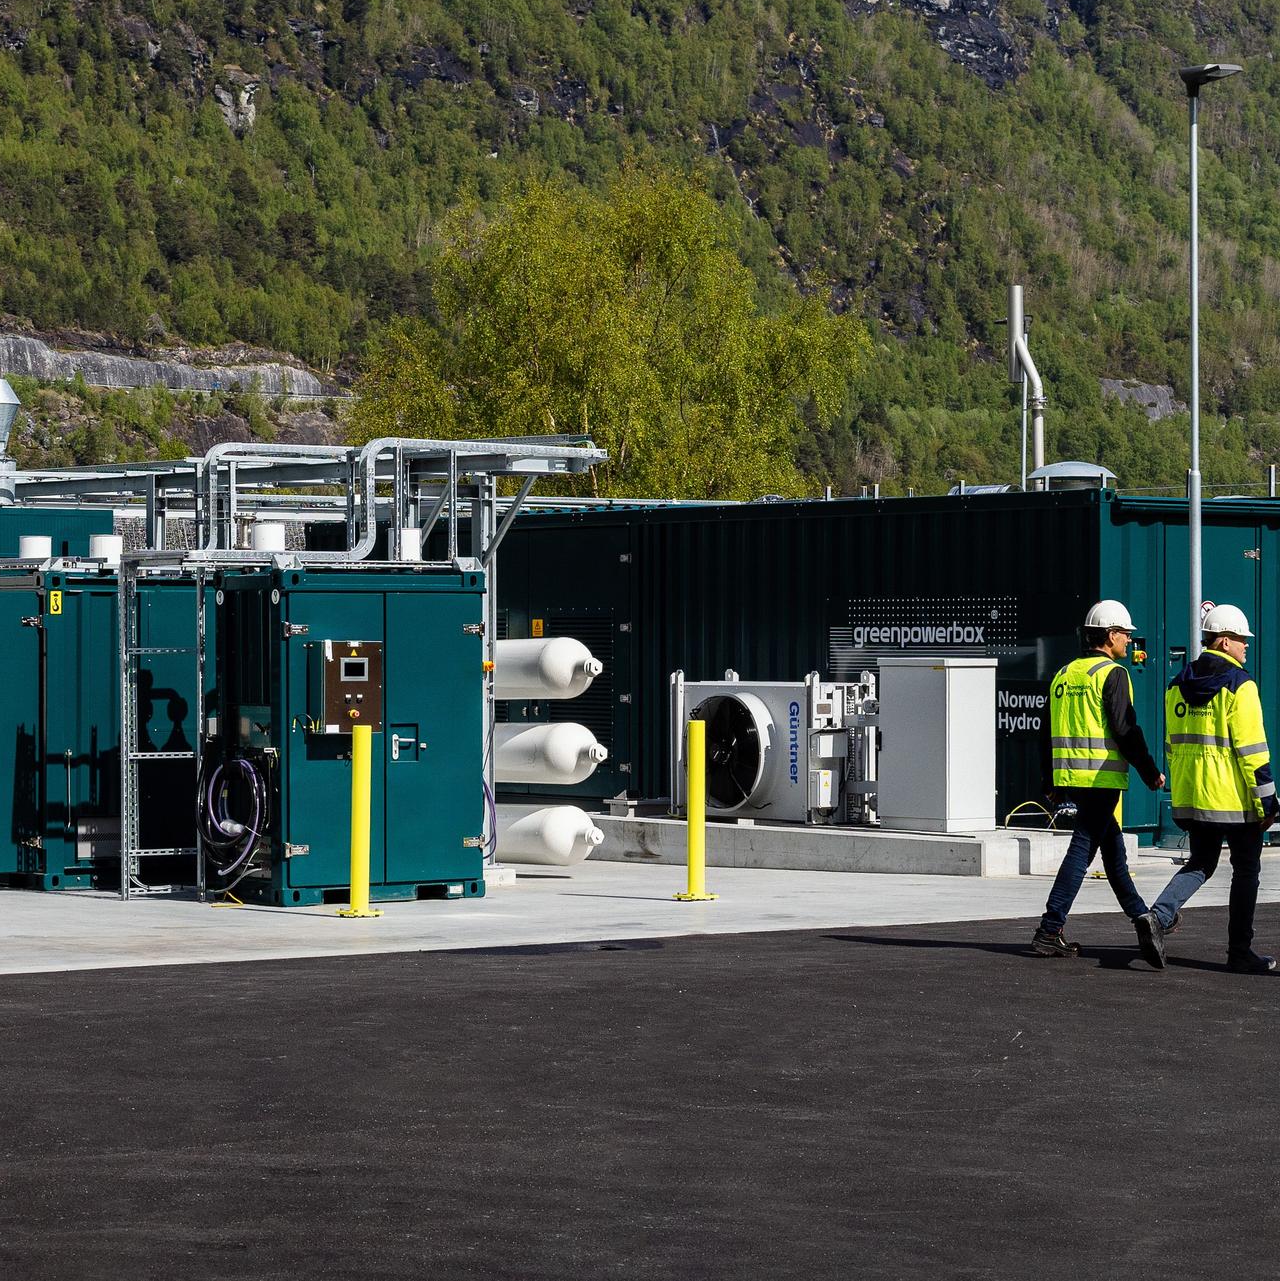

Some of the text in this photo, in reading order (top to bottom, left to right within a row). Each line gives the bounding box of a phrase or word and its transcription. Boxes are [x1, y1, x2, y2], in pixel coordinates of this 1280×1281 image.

[853, 621, 985, 648] greenpowerbox
[998, 690, 1048, 709] Norwe
[998, 712, 1041, 733] Hydro
[789, 701, 800, 784] Güntner
